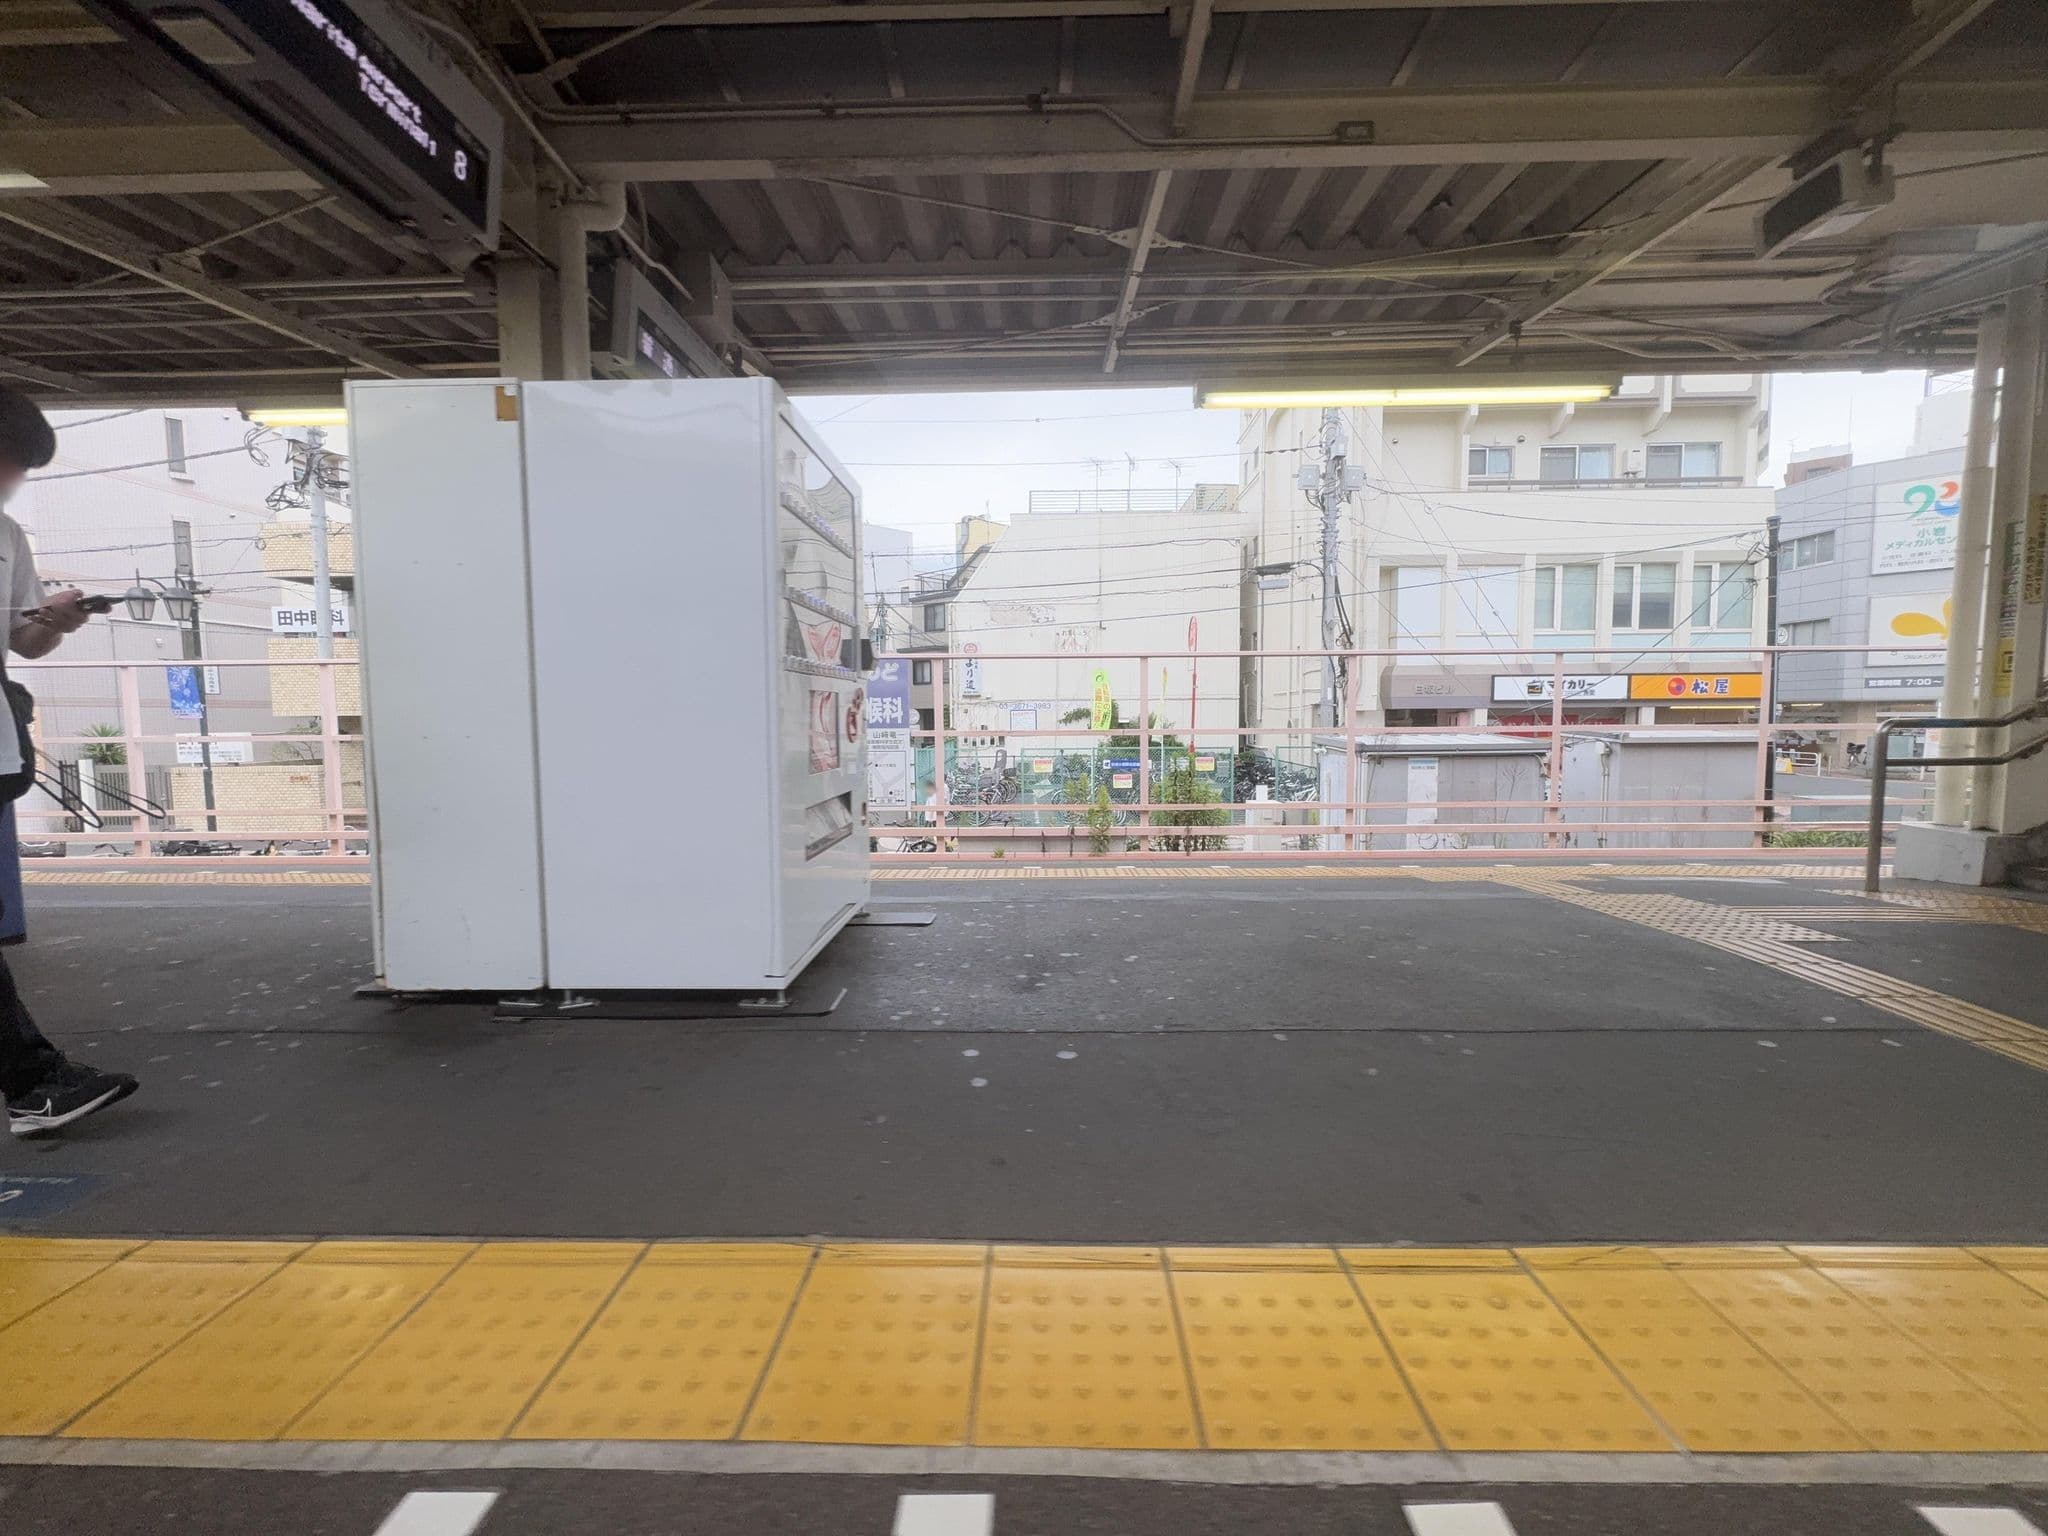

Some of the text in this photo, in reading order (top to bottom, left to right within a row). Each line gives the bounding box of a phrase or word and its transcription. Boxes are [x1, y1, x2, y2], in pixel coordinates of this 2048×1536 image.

[358, 71, 429, 149] Terminal
[453, 149, 468, 181] 8
[1691, 679, 1729, 695] 松屋
